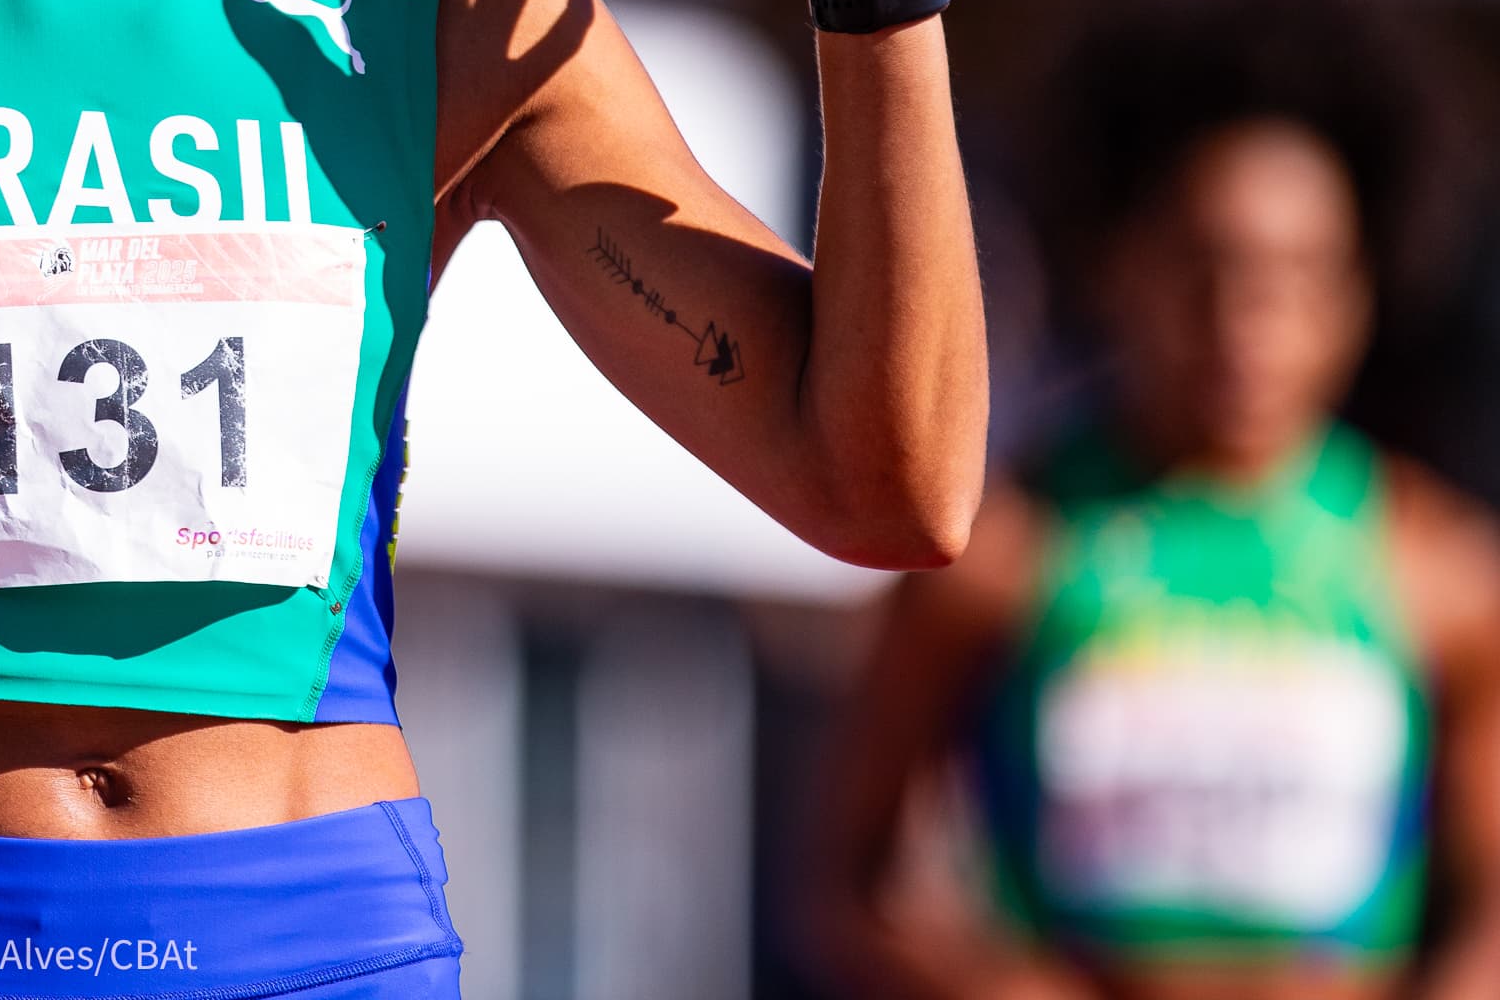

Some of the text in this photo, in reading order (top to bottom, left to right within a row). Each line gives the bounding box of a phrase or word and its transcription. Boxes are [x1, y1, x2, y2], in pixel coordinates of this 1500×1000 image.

[81, 237, 162, 261] MAR DEL
[79, 260, 198, 284] PLATA 2025
